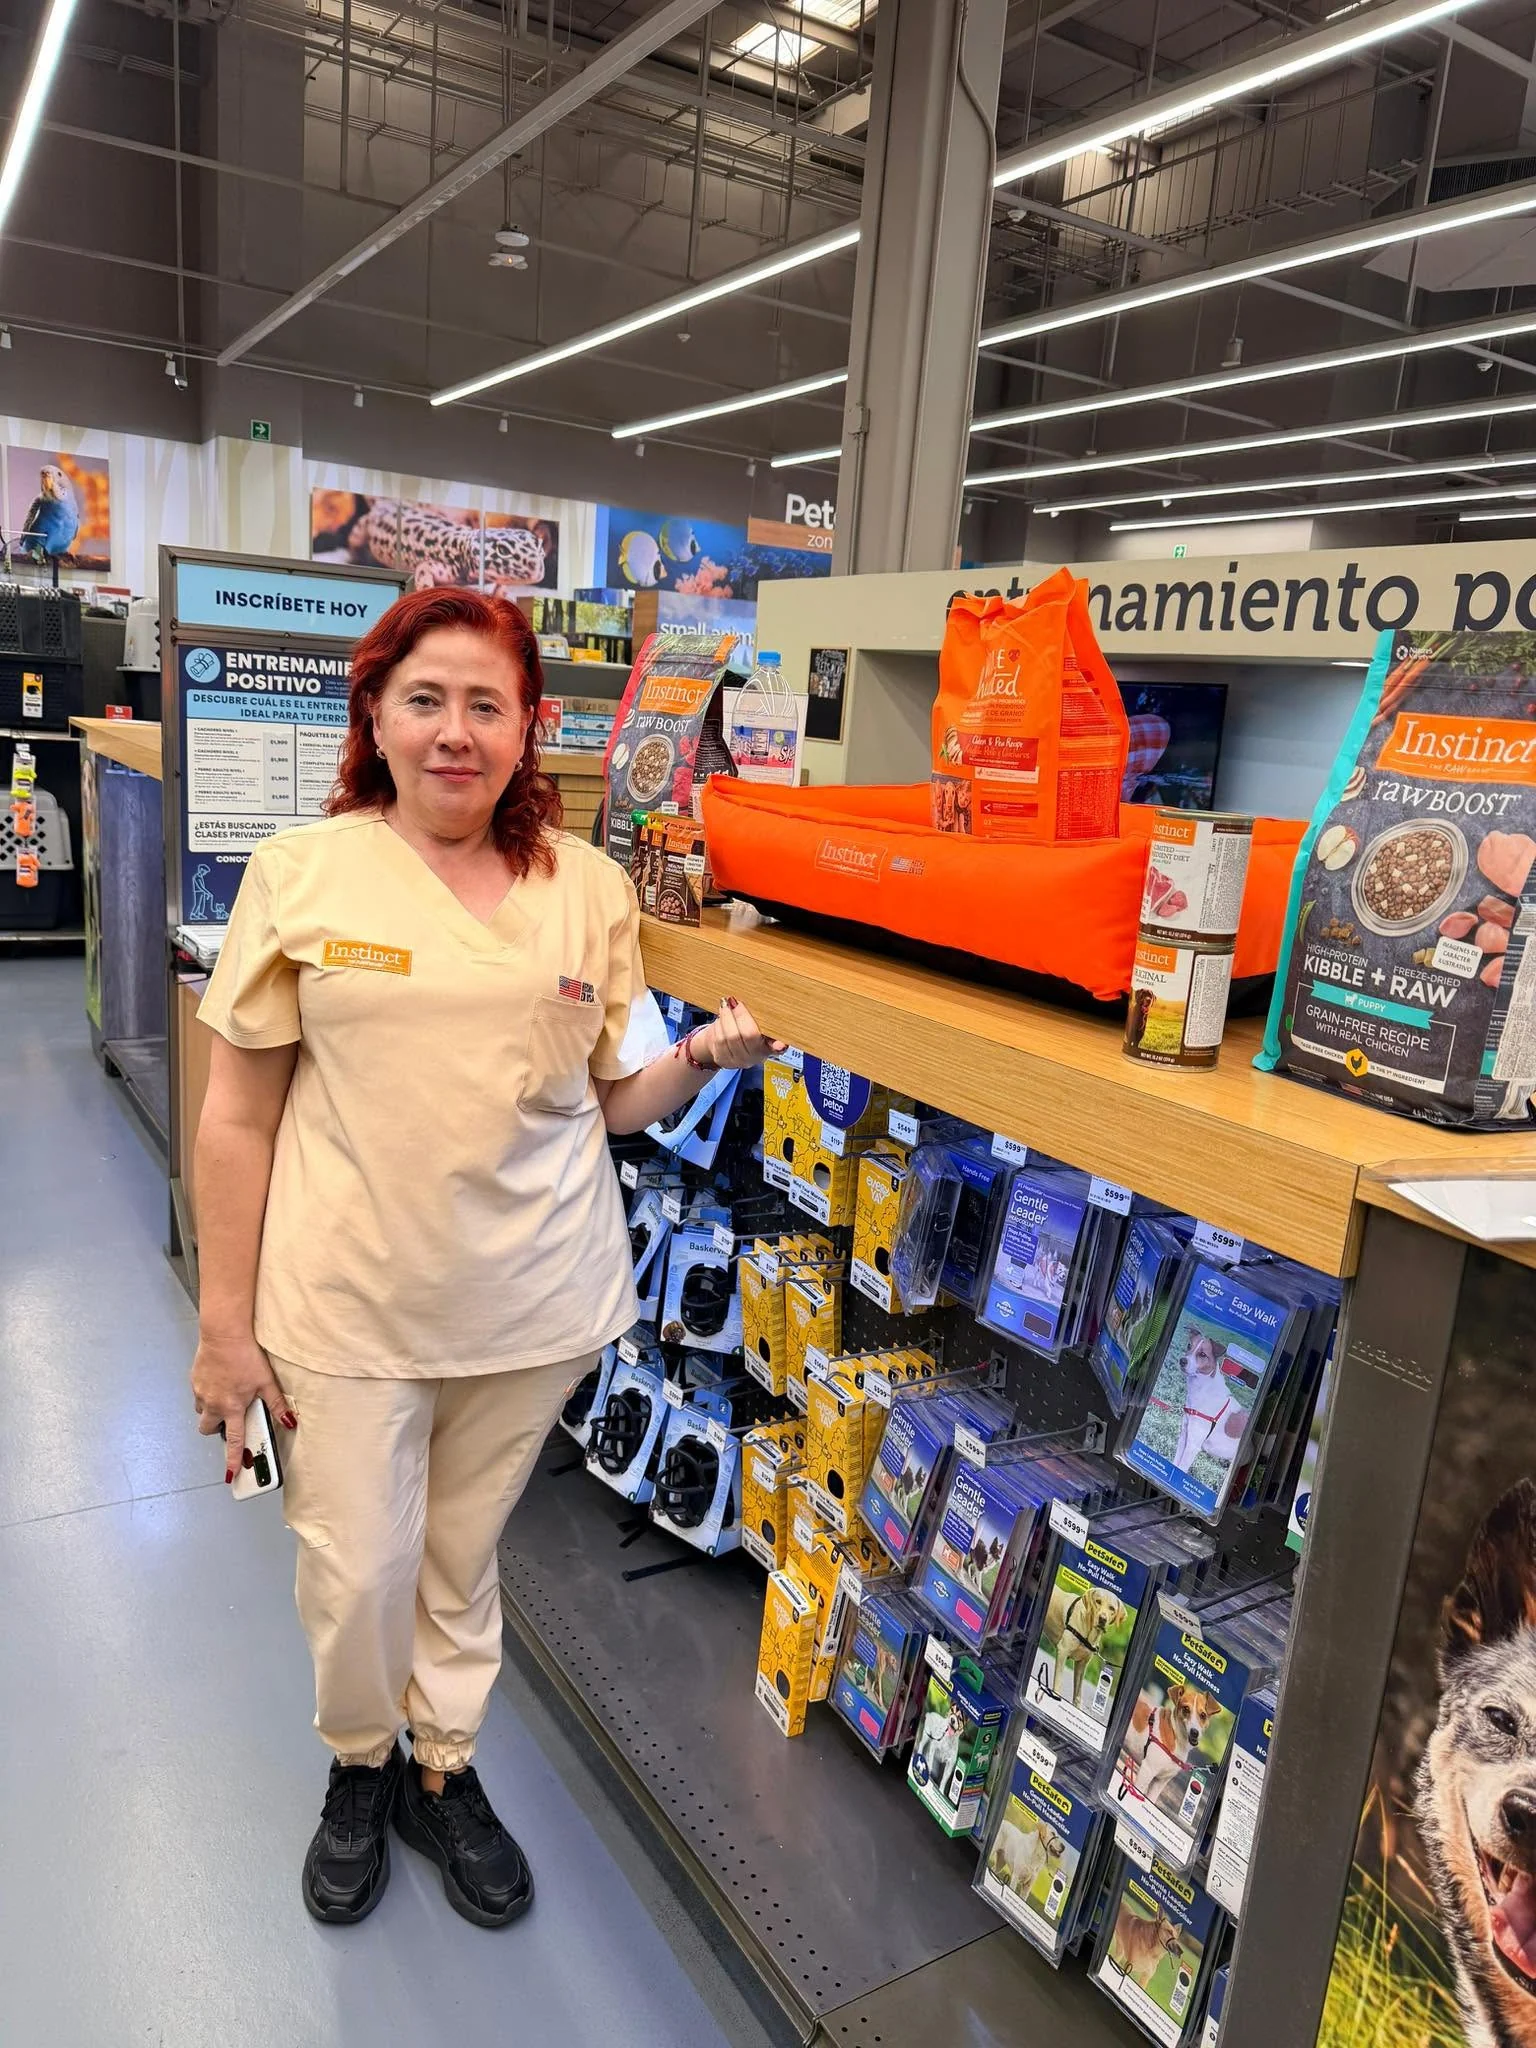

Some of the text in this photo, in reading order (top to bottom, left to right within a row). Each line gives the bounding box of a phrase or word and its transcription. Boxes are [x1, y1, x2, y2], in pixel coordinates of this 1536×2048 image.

[786, 493, 839, 530] Pet
[216, 590, 368, 618] INSCRÍBETE HOY
[660, 622, 706, 636] small
[226, 672, 322, 694] POSITIVO
[645, 680, 704, 705] Instinct
[193, 694, 349, 711] DESCUBRE CUÁL ES EL ENTREN
[241, 709, 348, 723] IDEAL PARA TU PERRO
[1395, 719, 1536, 765] Instinct
[194, 821, 277, 830] ¿ESTÁS BUSCANDO
[194, 831, 228, 839] CLASES
[610, 818, 634, 832] KIBBLE
[820, 839, 878, 869] Instinct
[1173, 854, 1190, 862] DIET
[330, 943, 402, 964] Instinct
[1306, 943, 1369, 967] HIGH-PROTEIN
[1468, 949, 1479, 957] DE
[1303, 954, 1364, 988] KIBBLE
[1389, 976, 1458, 1008] RAW
[1393, 965, 1461, 988] FREEZE-DRIED
[1357, 998, 1387, 1012] PUPPY
[1305, 1004, 1431, 1051] GRAIN-FREE RECIPE
[1315, 1021, 1410, 1058] WITH REAL CHICKEN
[1324, 1049, 1344, 1060] CHICKEN
[1392, 1071, 1426, 1085] INGREDIENT
[823, 1098, 844, 1114] petco
[1004, 1140, 1021, 1153] $599
[962, 1164, 991, 1183] Hands Free
[1013, 1190, 1049, 1212] Gentle
[1104, 1187, 1124, 1201] $599
[1010, 1204, 1047, 1226] Leader
[1212, 1231, 1235, 1248] $599
[1200, 1279, 1225, 1297] PetSafe
[1231, 1296, 1279, 1328] Easy Walk
[892, 1406, 916, 1438] Gentle
[889, 1420, 913, 1448] Leader
[951, 1486, 984, 1518] Leader
[955, 1475, 986, 1508] Gentle
[1063, 1516, 1080, 1534] $599
[1088, 1544, 1118, 1567] PetSafe
[1077, 1562, 1100, 1580] No-Pull
[1099, 1574, 1123, 1594] Harness
[1087, 1560, 1100, 1573] Easy
[1100, 1566, 1116, 1580] Walk
[1184, 1633, 1217, 1664] PetSafe
[1172, 1653, 1196, 1676] No-Pull
[1195, 1671, 1220, 1695] Harness
[1183, 1652, 1197, 1667] Easy
[1197, 1662, 1214, 1680] Walk
[1032, 1775, 1064, 1807] PetSafe
[1022, 1791, 1042, 1812] No-Pull
[1041, 1807, 1071, 1836] Headcollar
[1029, 1789, 1047, 1806] Gentle
[1046, 1802, 1066, 1822] Leader
[1153, 1861, 1184, 1893] PetSafe
[1140, 1875, 1161, 1899] No-Pull
[1161, 1895, 1193, 1926] Headcollar
[1148, 1874, 1167, 1894] Gentle
[1167, 1891, 1188, 1912] Leader
